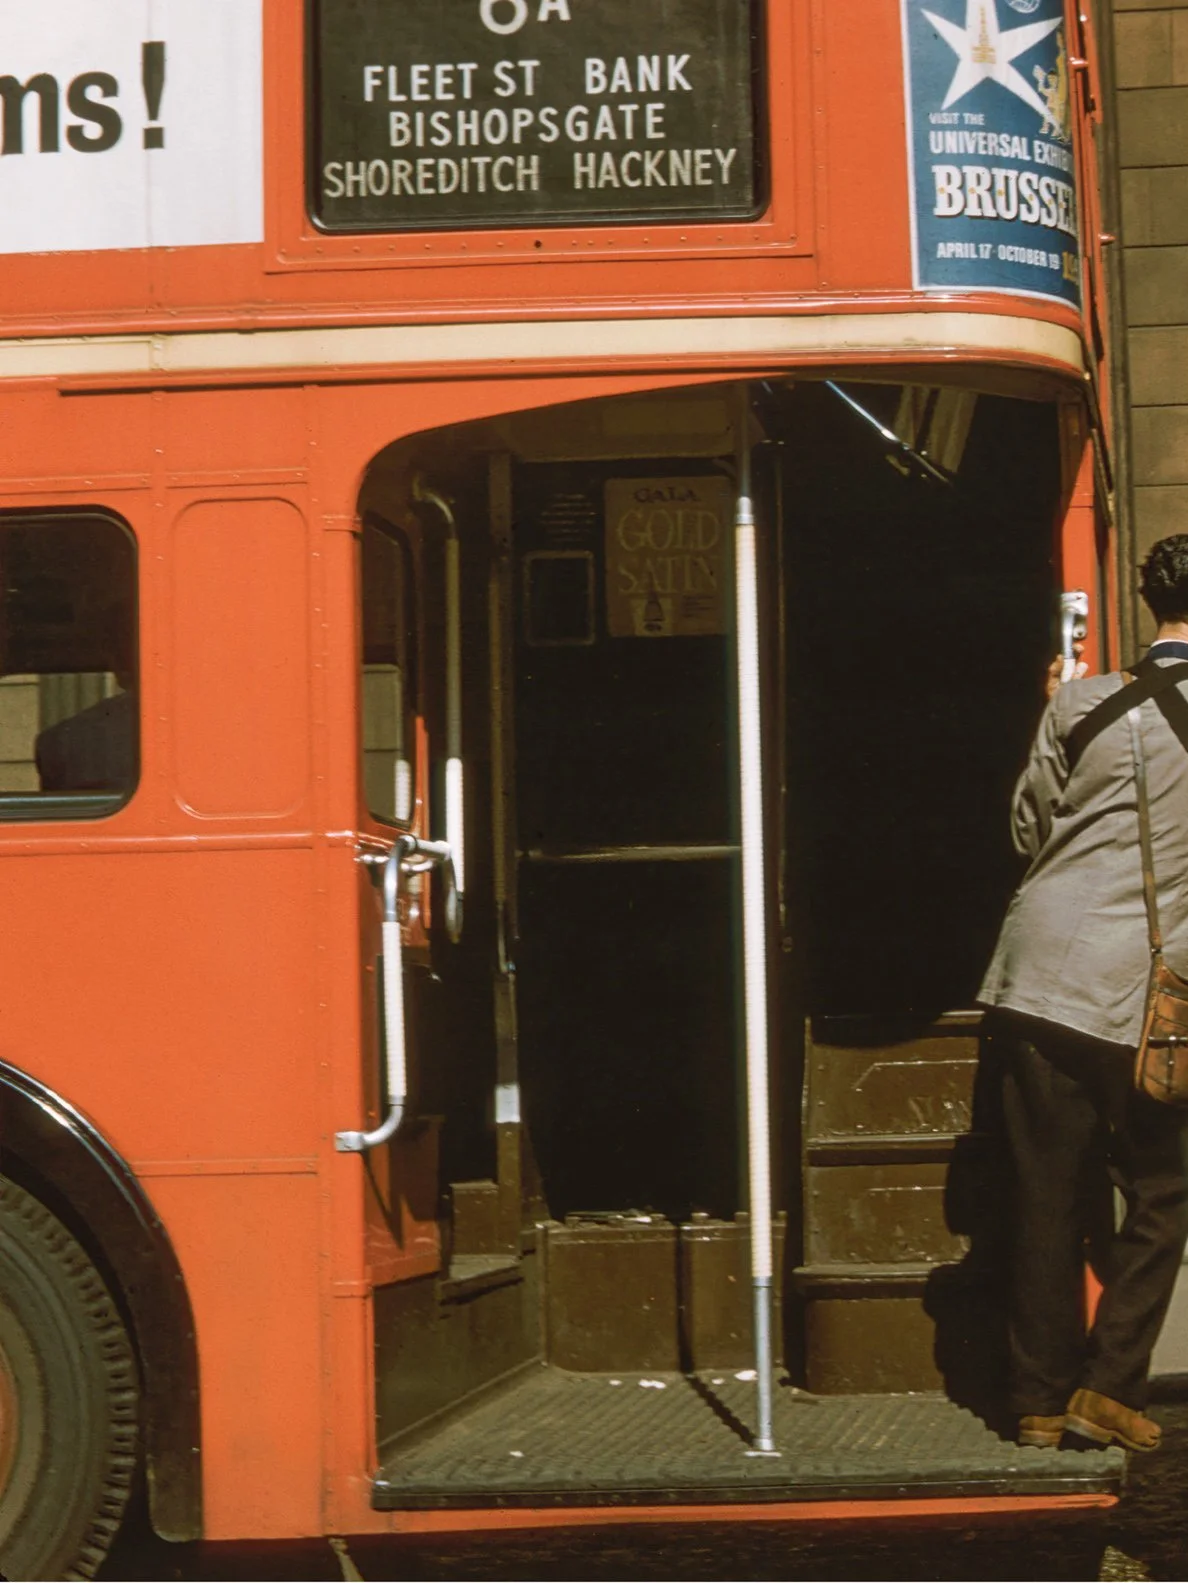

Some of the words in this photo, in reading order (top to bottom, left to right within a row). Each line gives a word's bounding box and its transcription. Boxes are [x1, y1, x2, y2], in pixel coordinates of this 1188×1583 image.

[364, 63, 478, 101] FLEET
[494, 60, 540, 97] ST
[585, 54, 693, 94] BANK
[389, 103, 666, 147] BISHOPSGATE
[929, 112, 960, 124] VISIT
[963, 112, 985, 125] THE
[929, 130, 1031, 161] UNIVERSAL
[323, 155, 539, 197] SHOREDITCH
[574, 148, 737, 189] HACKNEY
[936, 242, 978, 258] APRIL
[978, 243, 992, 259] 17
[997, 244, 1047, 267] OCTOBER
[616, 508, 721, 551] GOLD
[617, 554, 722, 594] SATIN
